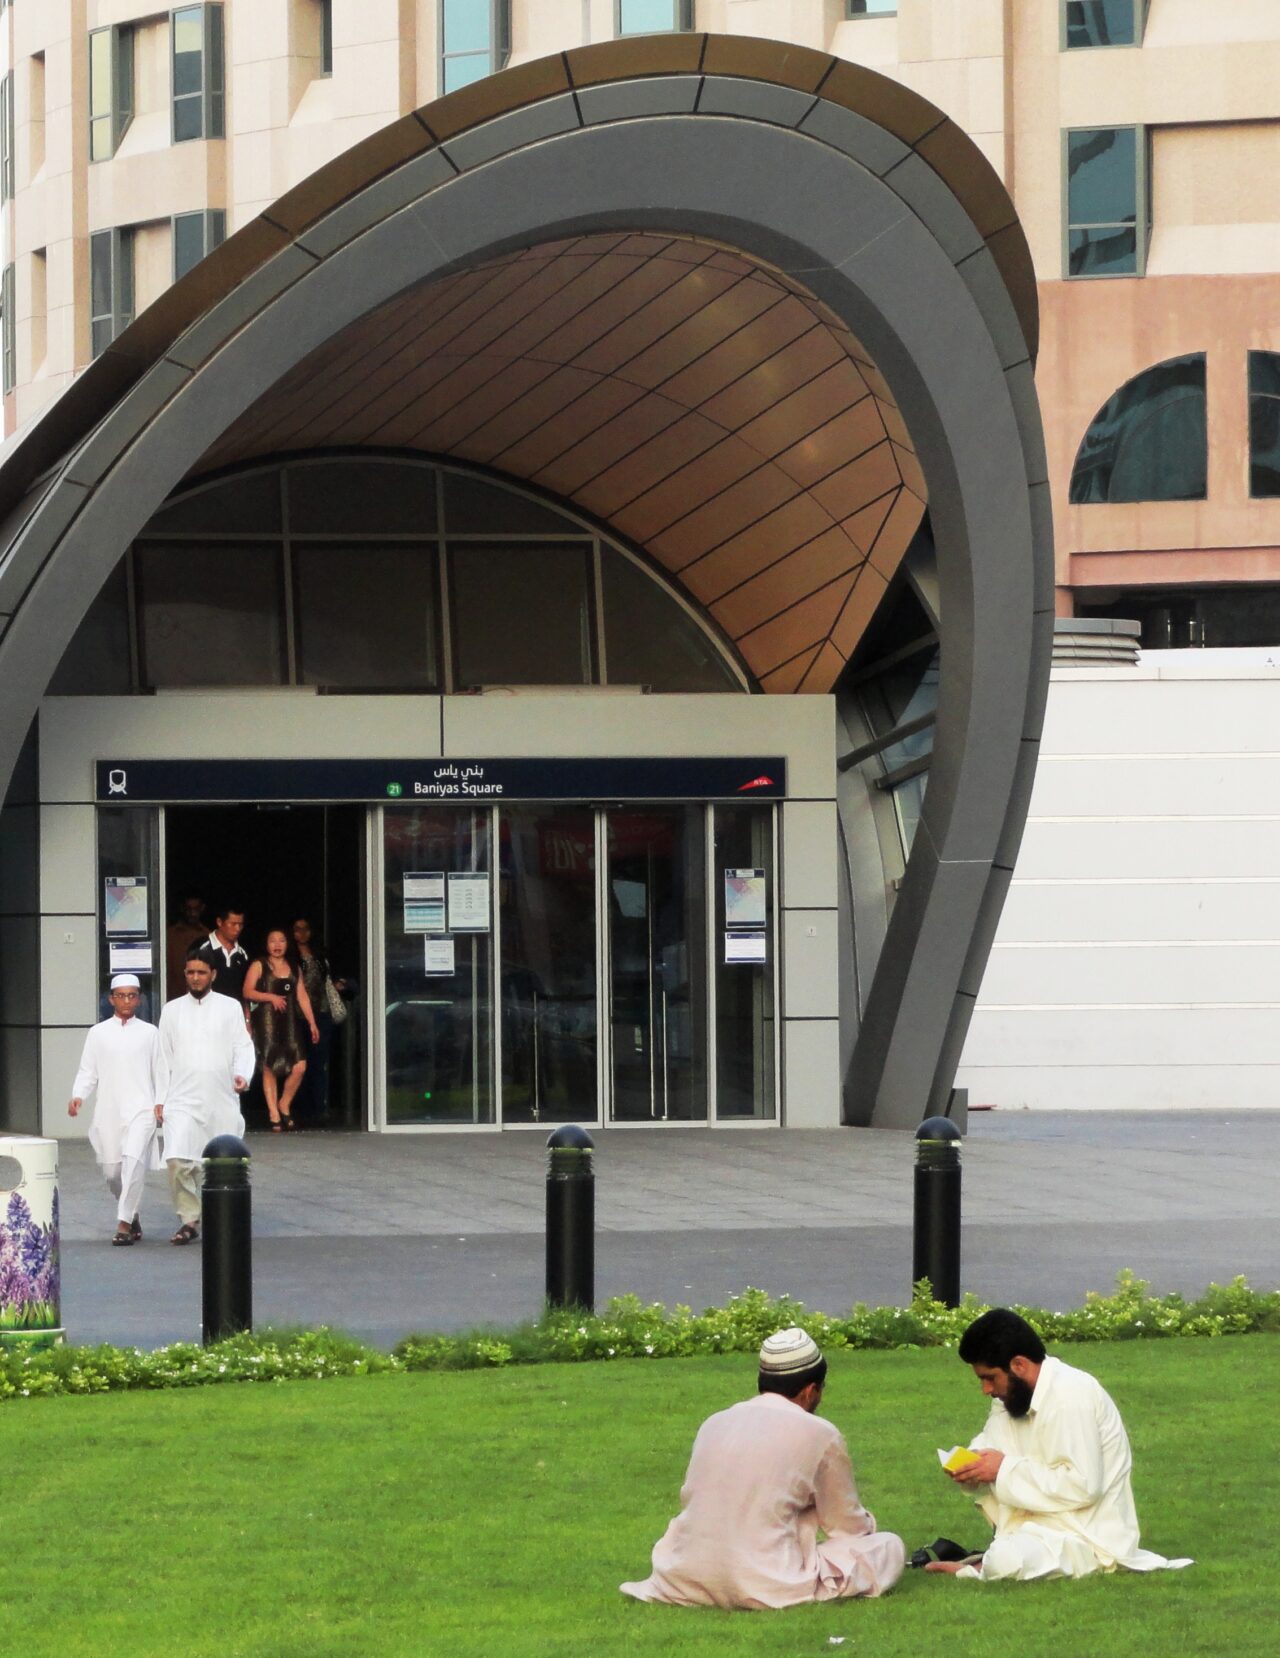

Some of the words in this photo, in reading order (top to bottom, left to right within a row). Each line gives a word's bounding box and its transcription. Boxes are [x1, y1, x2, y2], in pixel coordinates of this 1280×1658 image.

[434, 763, 458, 778] ياس
[461, 764, 484, 780] بني
[389, 785, 400, 794] 21
[414, 782, 459, 796] Baniyas
[461, 782, 503, 796] Square
